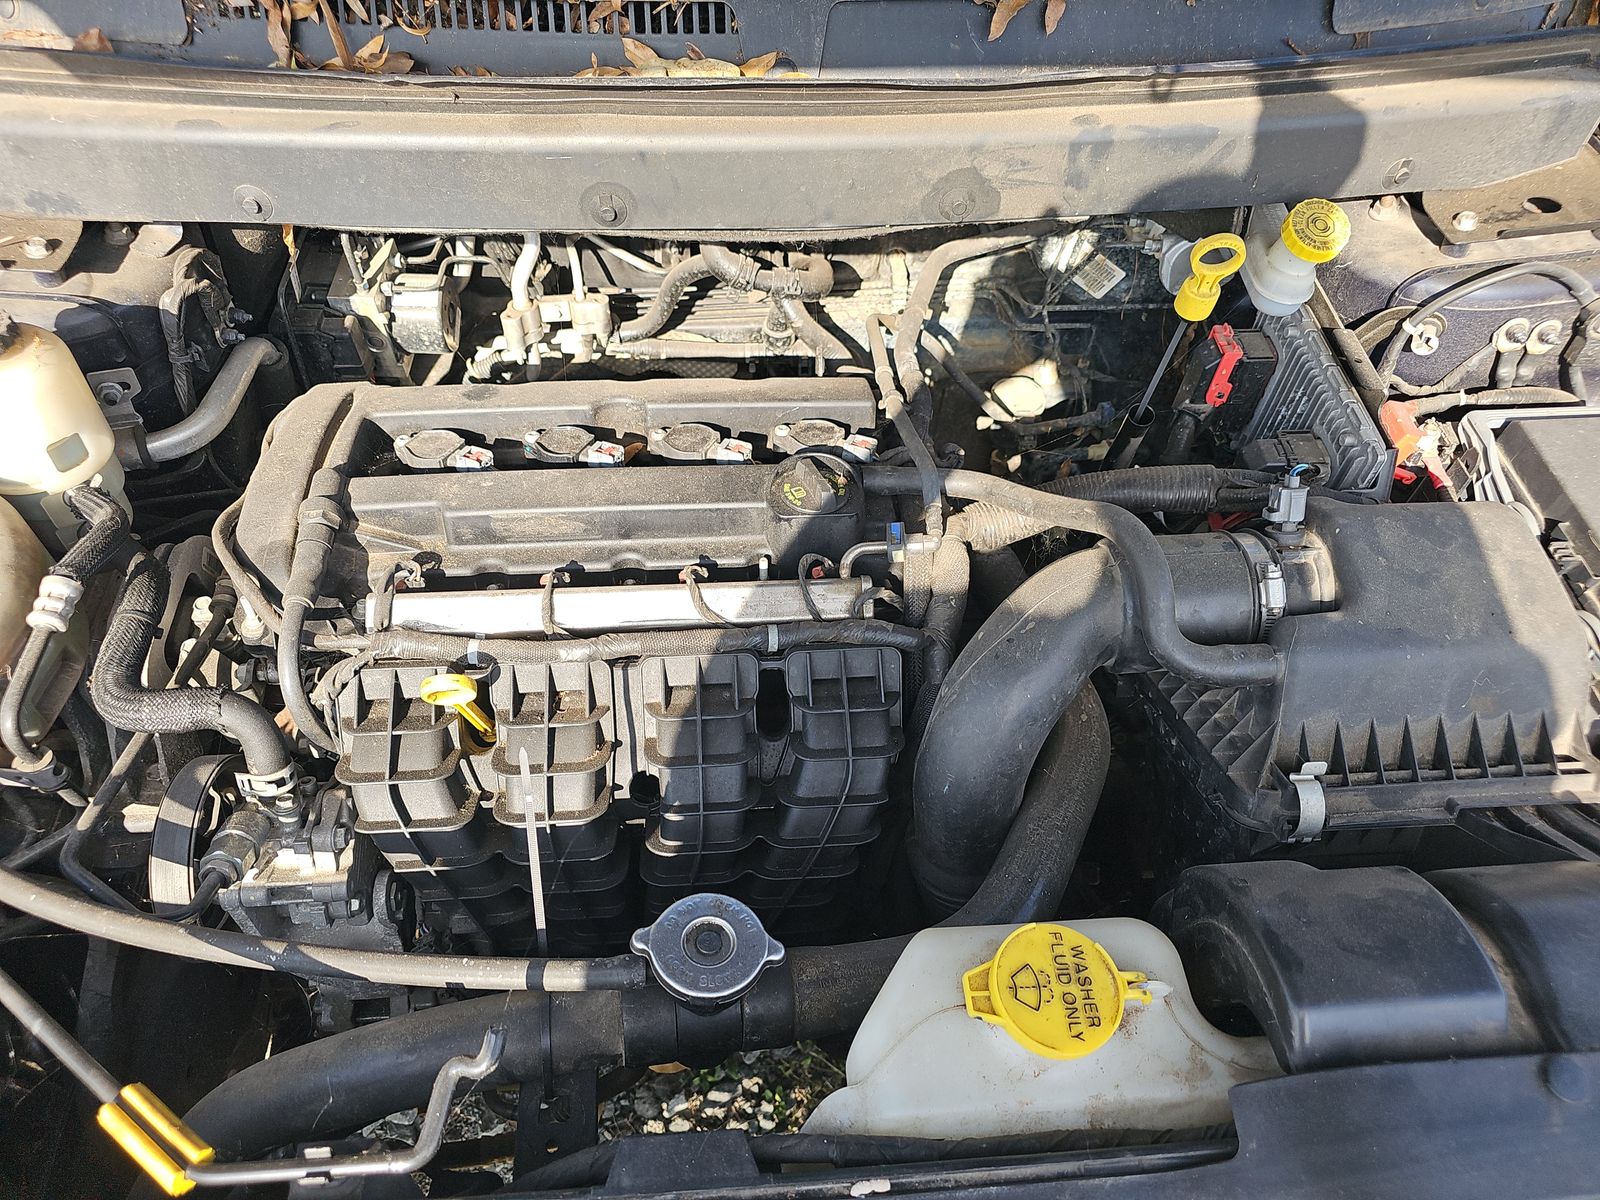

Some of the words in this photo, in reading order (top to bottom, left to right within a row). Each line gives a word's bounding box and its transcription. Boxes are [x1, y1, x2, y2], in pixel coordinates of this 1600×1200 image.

[1048, 931, 1072, 986] FLUID
[1061, 991, 1086, 1042] ONLY
[1070, 944, 1102, 1028] WASHER
